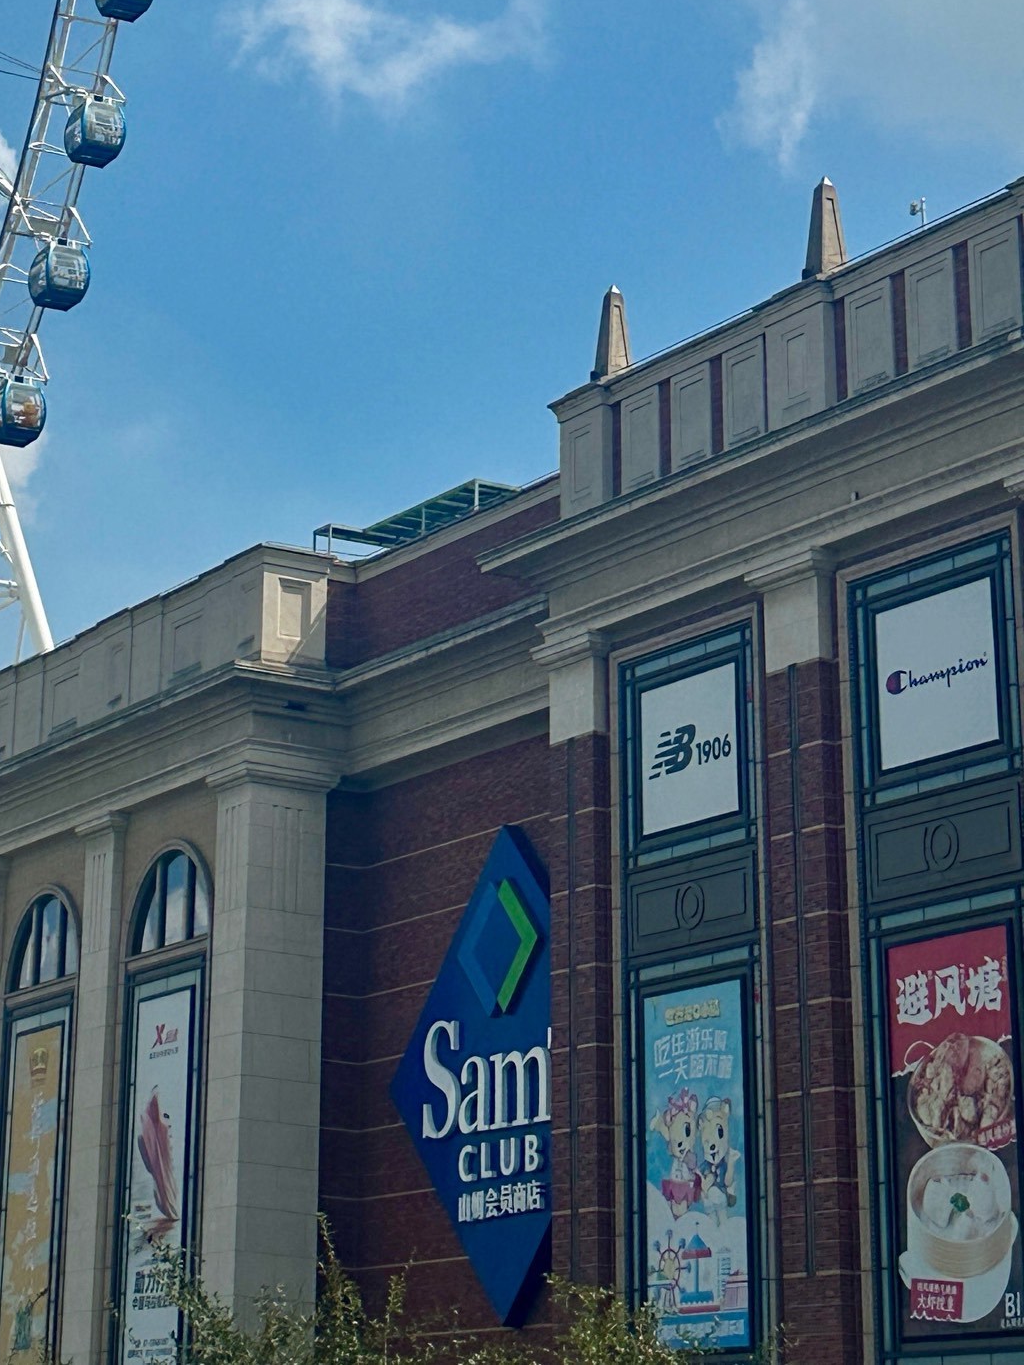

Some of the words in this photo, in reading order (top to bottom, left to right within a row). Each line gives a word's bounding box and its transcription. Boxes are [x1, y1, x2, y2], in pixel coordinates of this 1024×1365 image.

[886, 657, 988, 695] Champion
[696, 733, 732, 765] 1906
[896, 956, 1002, 1026] 避风塘
[458, 1134, 544, 1183] CLUB
[458, 1180, 546, 1223] 山姆会员商店
